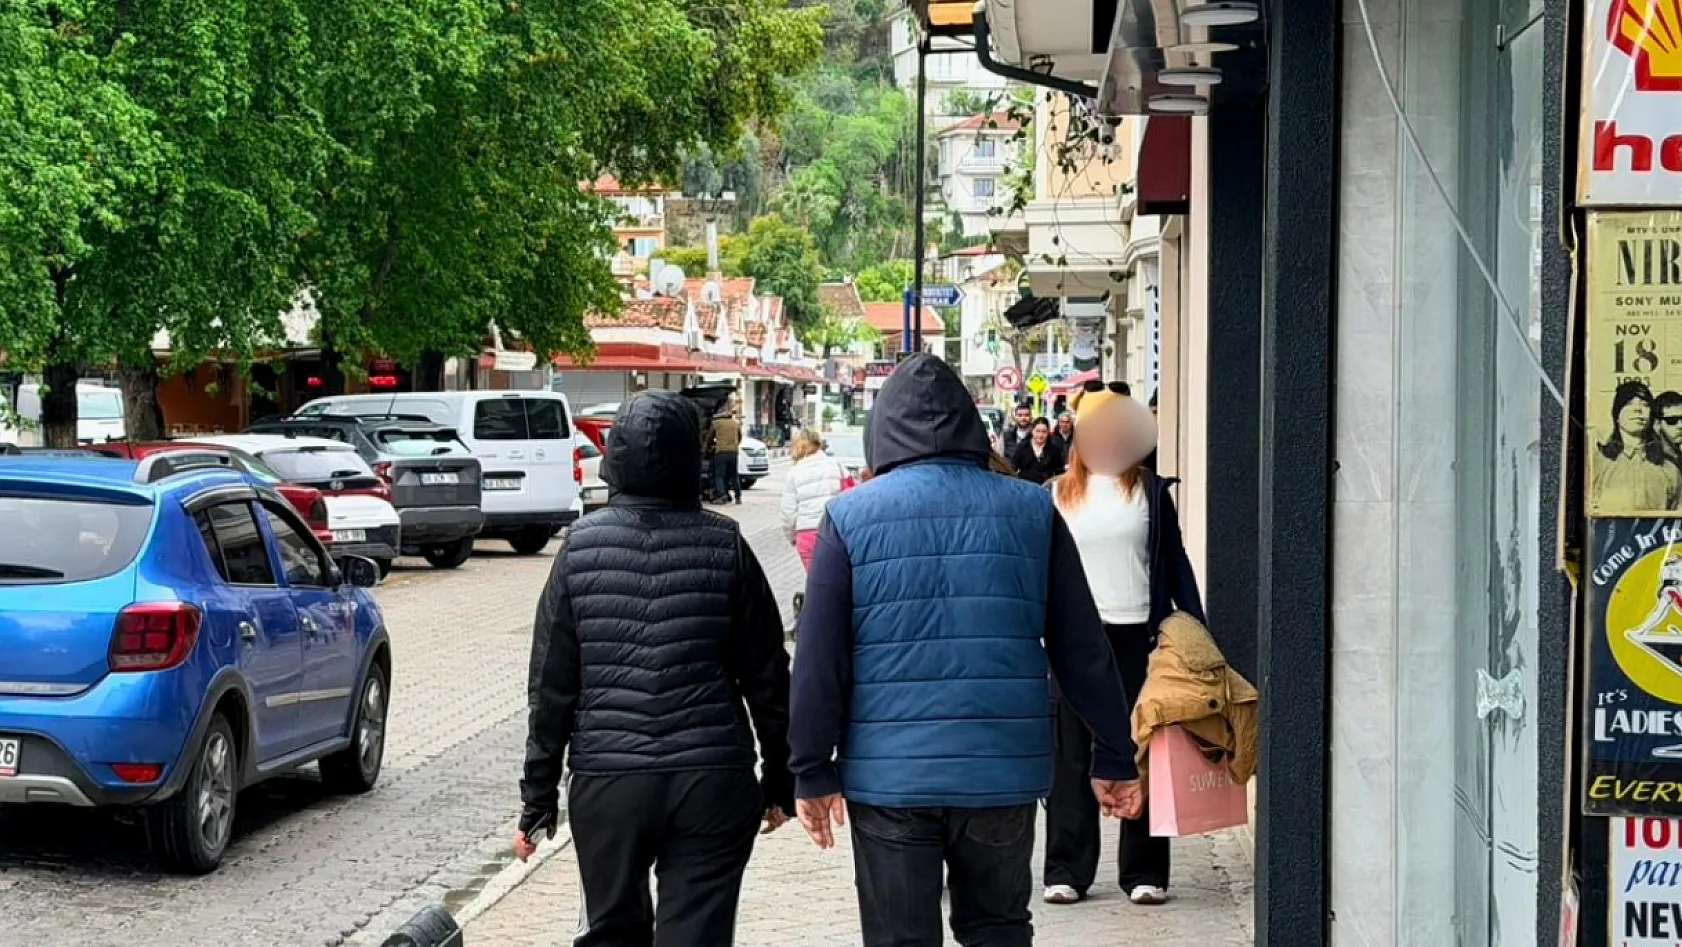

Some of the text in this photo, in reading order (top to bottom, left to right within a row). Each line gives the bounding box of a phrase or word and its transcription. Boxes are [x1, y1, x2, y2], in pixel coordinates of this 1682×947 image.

[1616, 296, 1681, 306] SONY MU
[1616, 324, 1650, 335] NOV
[1614, 339, 1658, 373] 18
[1592, 545, 1635, 585] Come
[1635, 534, 1657, 549] In
